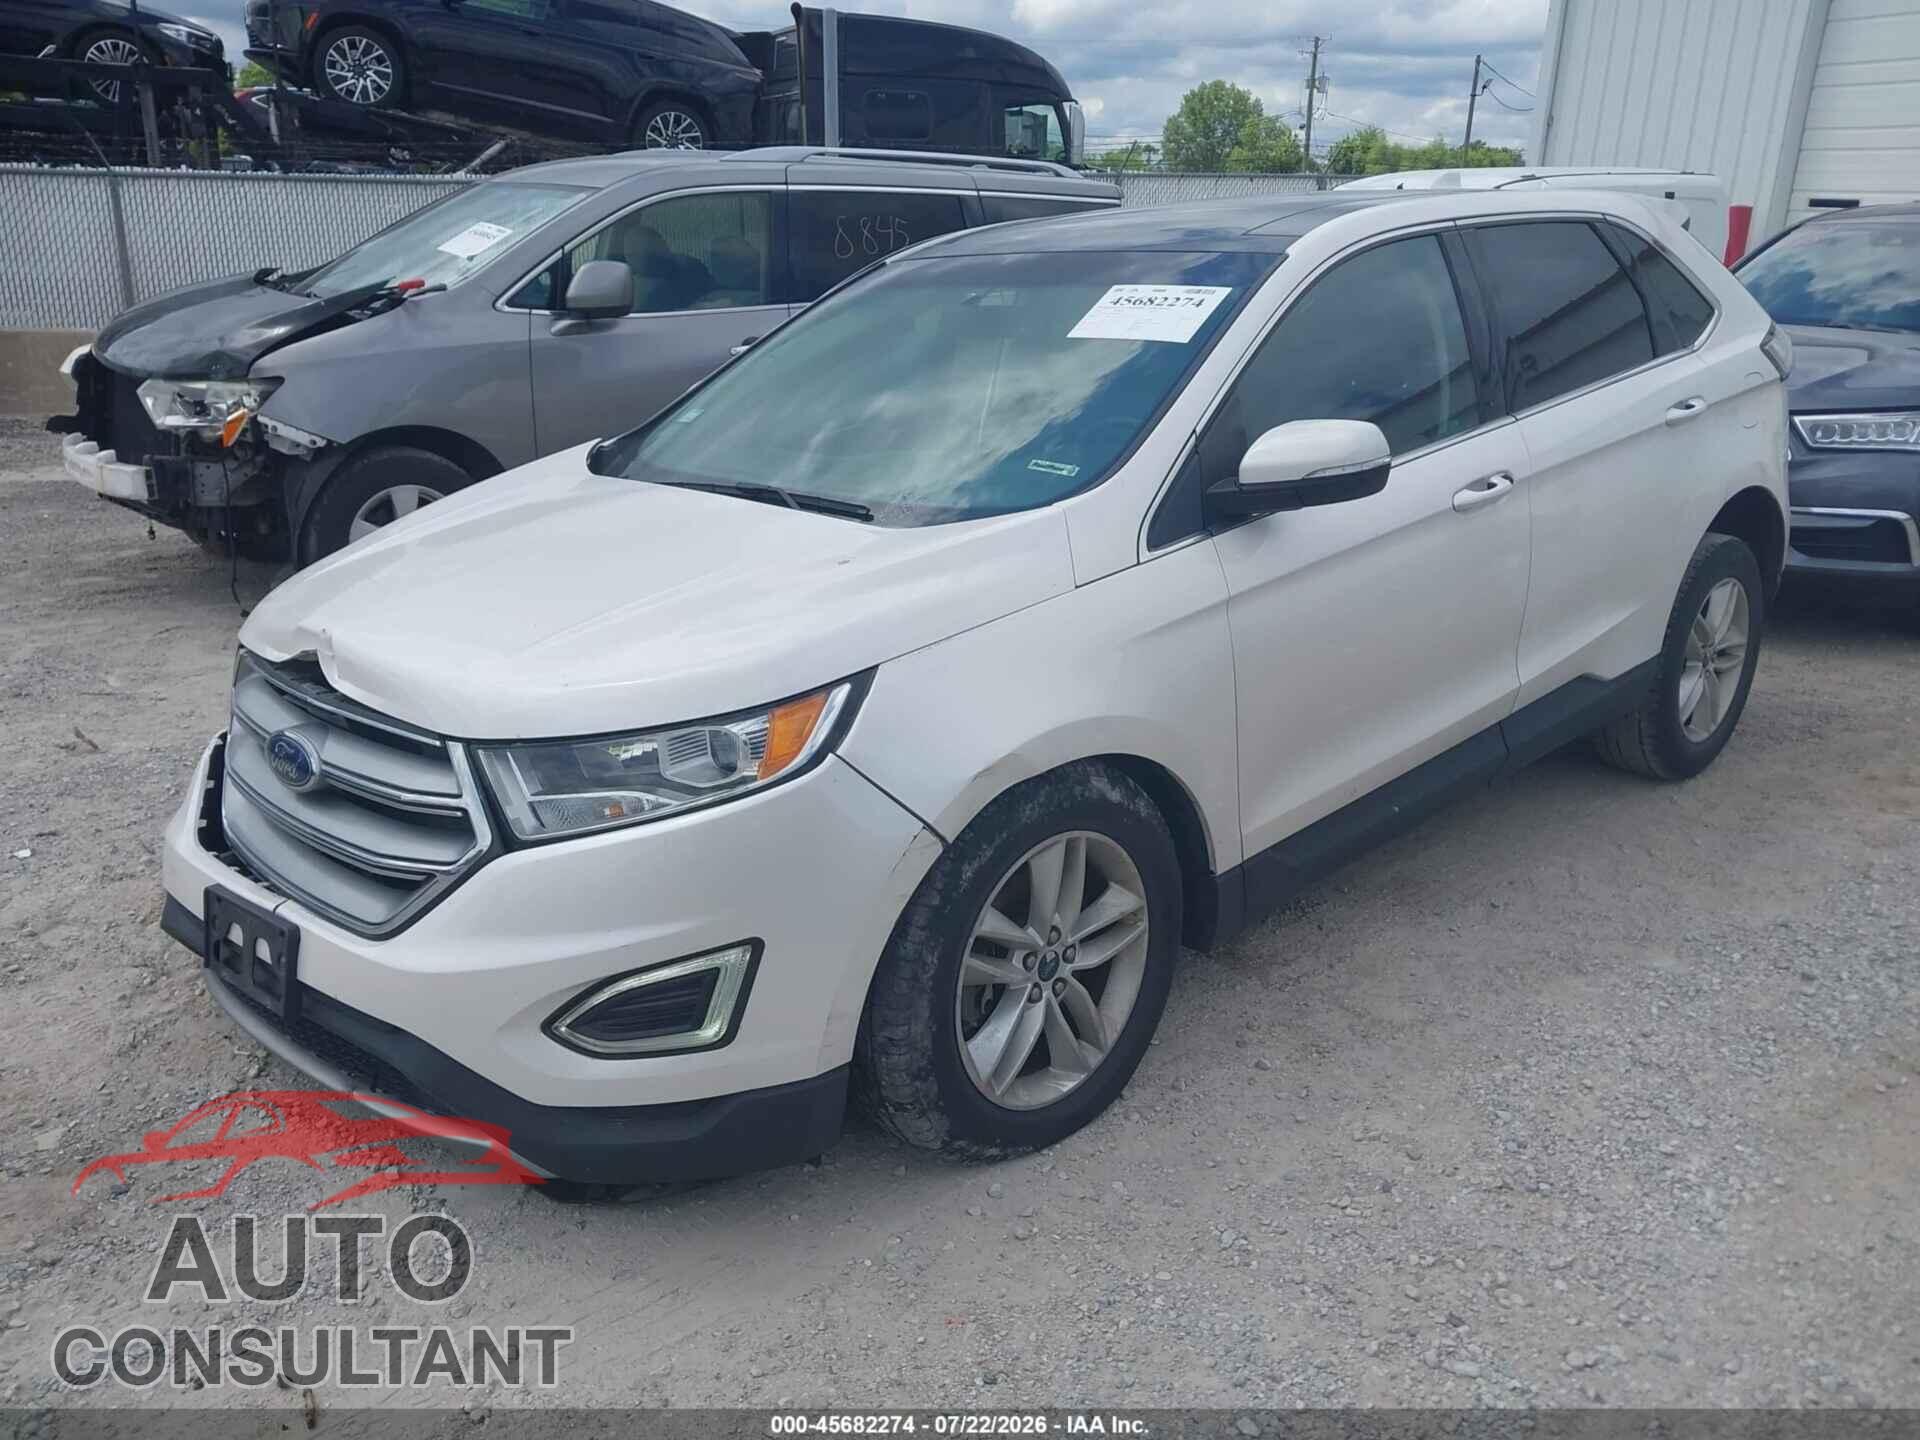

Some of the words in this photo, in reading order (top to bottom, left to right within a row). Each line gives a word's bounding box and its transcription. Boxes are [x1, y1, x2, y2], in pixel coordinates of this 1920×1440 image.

[834, 215, 910, 259] 8845
[1109, 295, 1206, 309] 45682274
[270, 741, 300, 780] Ford
